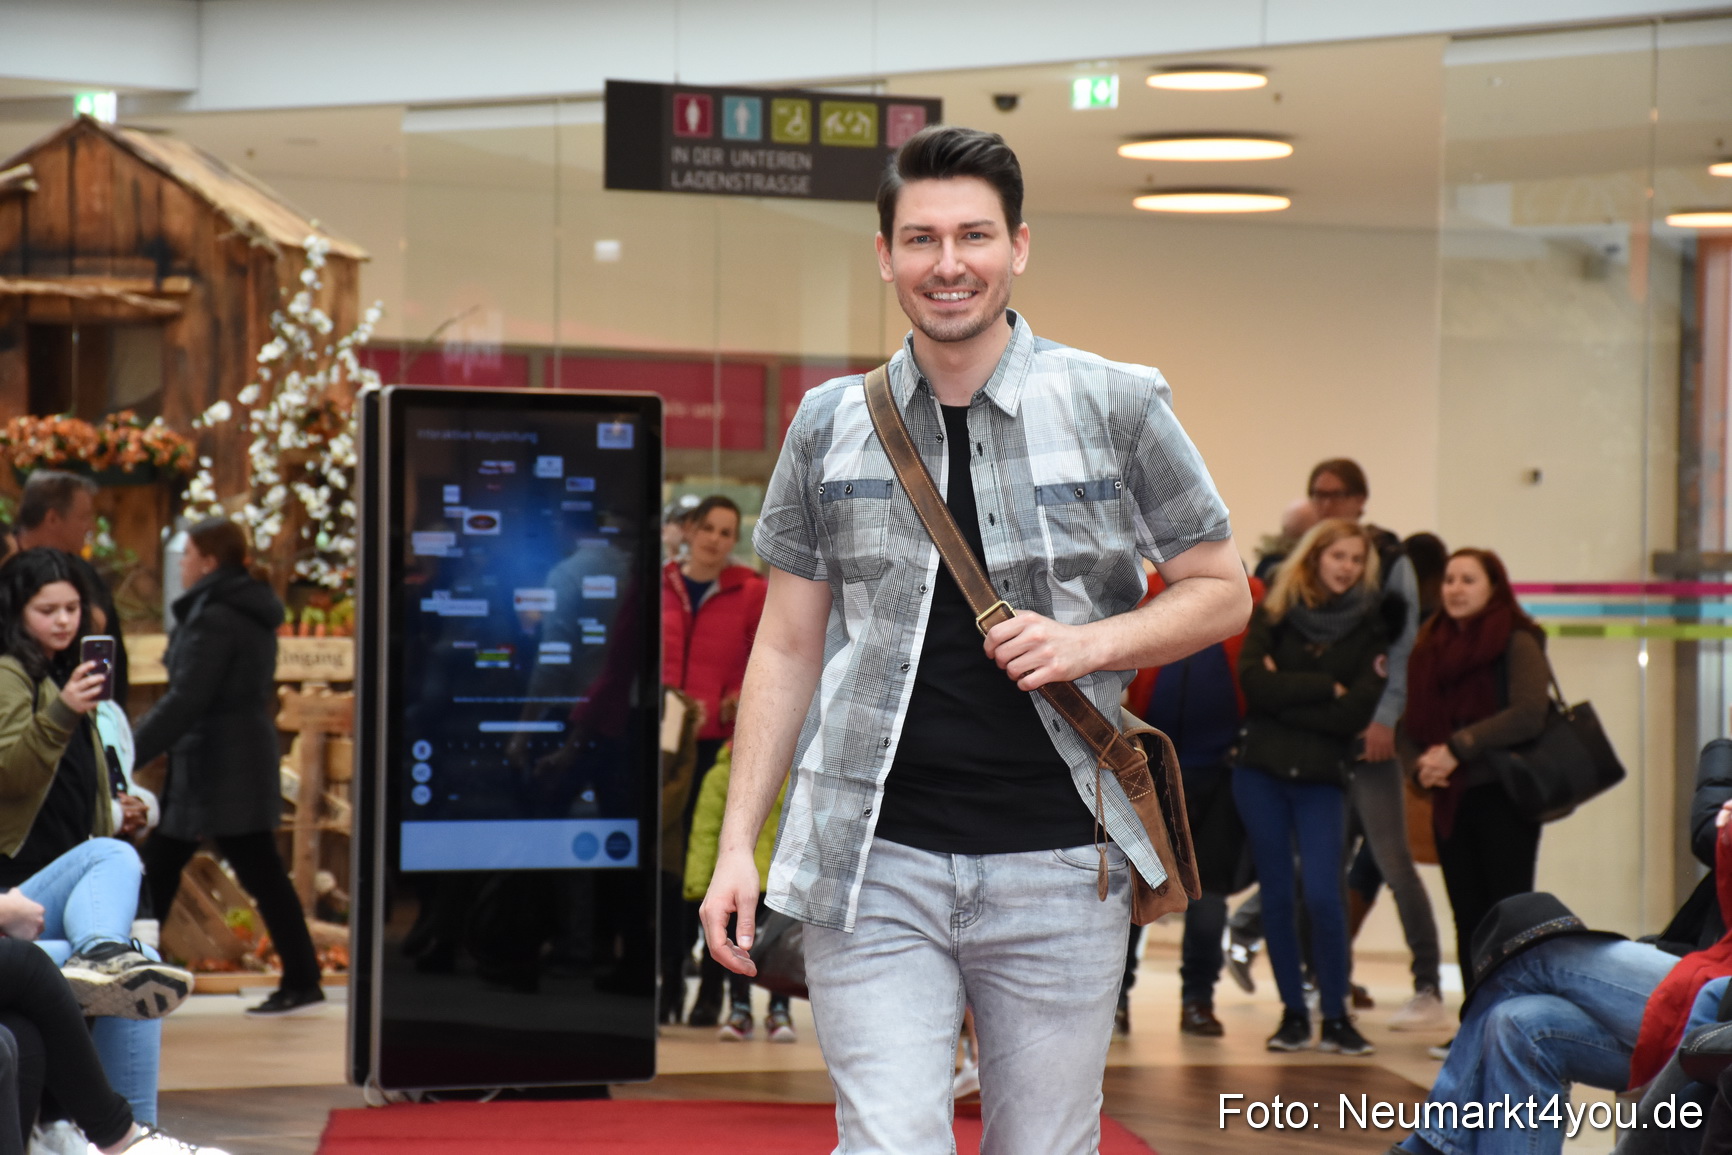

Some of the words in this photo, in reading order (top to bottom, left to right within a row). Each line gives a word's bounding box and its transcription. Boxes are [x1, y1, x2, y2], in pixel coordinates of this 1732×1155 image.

[671, 146, 690, 165] IN
[693, 147, 725, 166] DER
[731, 149, 812, 171] UNTEREN
[671, 169, 811, 195] LADENSTRASSE
[279, 648, 344, 670] ingang
